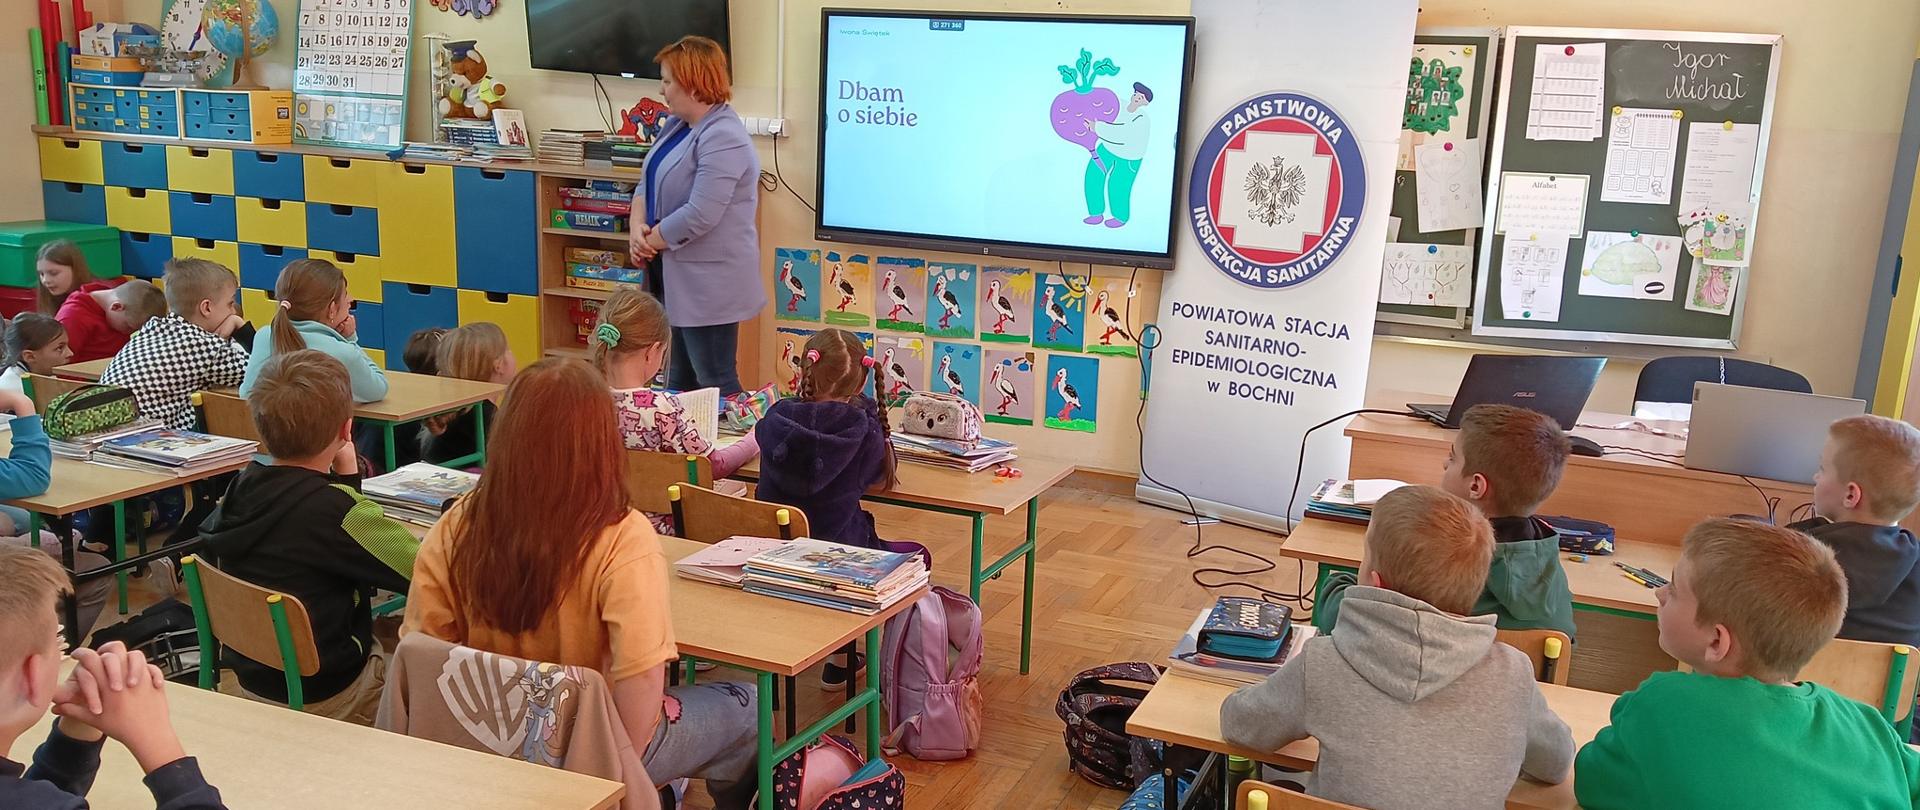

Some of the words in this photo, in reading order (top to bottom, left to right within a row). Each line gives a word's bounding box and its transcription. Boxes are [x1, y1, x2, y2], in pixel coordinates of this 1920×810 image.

[384, 0, 390, 10] 5
[304, 14, 309, 25] 7
[319, 14, 325, 24] 8
[336, 14, 342, 26] 9
[348, 15, 359, 26] 10
[363, 16, 374, 26] 11
[379, 16, 391, 27] 12
[395, 17, 408, 27] 13
[300, 37, 310, 48] 14
[315, 34, 326, 45] 15
[331, 36, 342, 46] 16
[346, 35, 357, 46] 17
[362, 36, 374, 46] 18
[377, 36, 389, 47] 19
[394, 37, 407, 47] 20
[299, 57, 309, 67] 21
[314, 54, 325, 64] 22
[329, 55, 341, 65] 23
[345, 55, 356, 65] 24
[360, 55, 372, 66] 25
[375, 56, 387, 67] 26
[392, 57, 404, 68] 27
[1663, 42, 1731, 80] Igor
[299, 75, 310, 86] 28
[313, 75, 324, 85] 29
[327, 75, 338, 86] 30
[343, 77, 354, 87] 31
[838, 80, 903, 102] Dbam
[1666, 73, 1747, 101] Michał
[838, 108, 850, 122] o
[855, 105, 918, 126] siebie
[1220, 99, 1343, 145] PAŃSTWOWA
[1194, 206, 1261, 282] INSPEKCJA
[1266, 216, 1354, 283] SANITARNA
[1172, 302, 1275, 330] POWIATOWA
[1284, 317, 1350, 340] STACJA
[1205, 330, 1306, 358] SANITARNO-
[1172, 349, 1337, 389] EPIDEMIOLOGICZNA
[1207, 381, 1220, 393] w
[1228, 381, 1294, 406] BOCHNI
